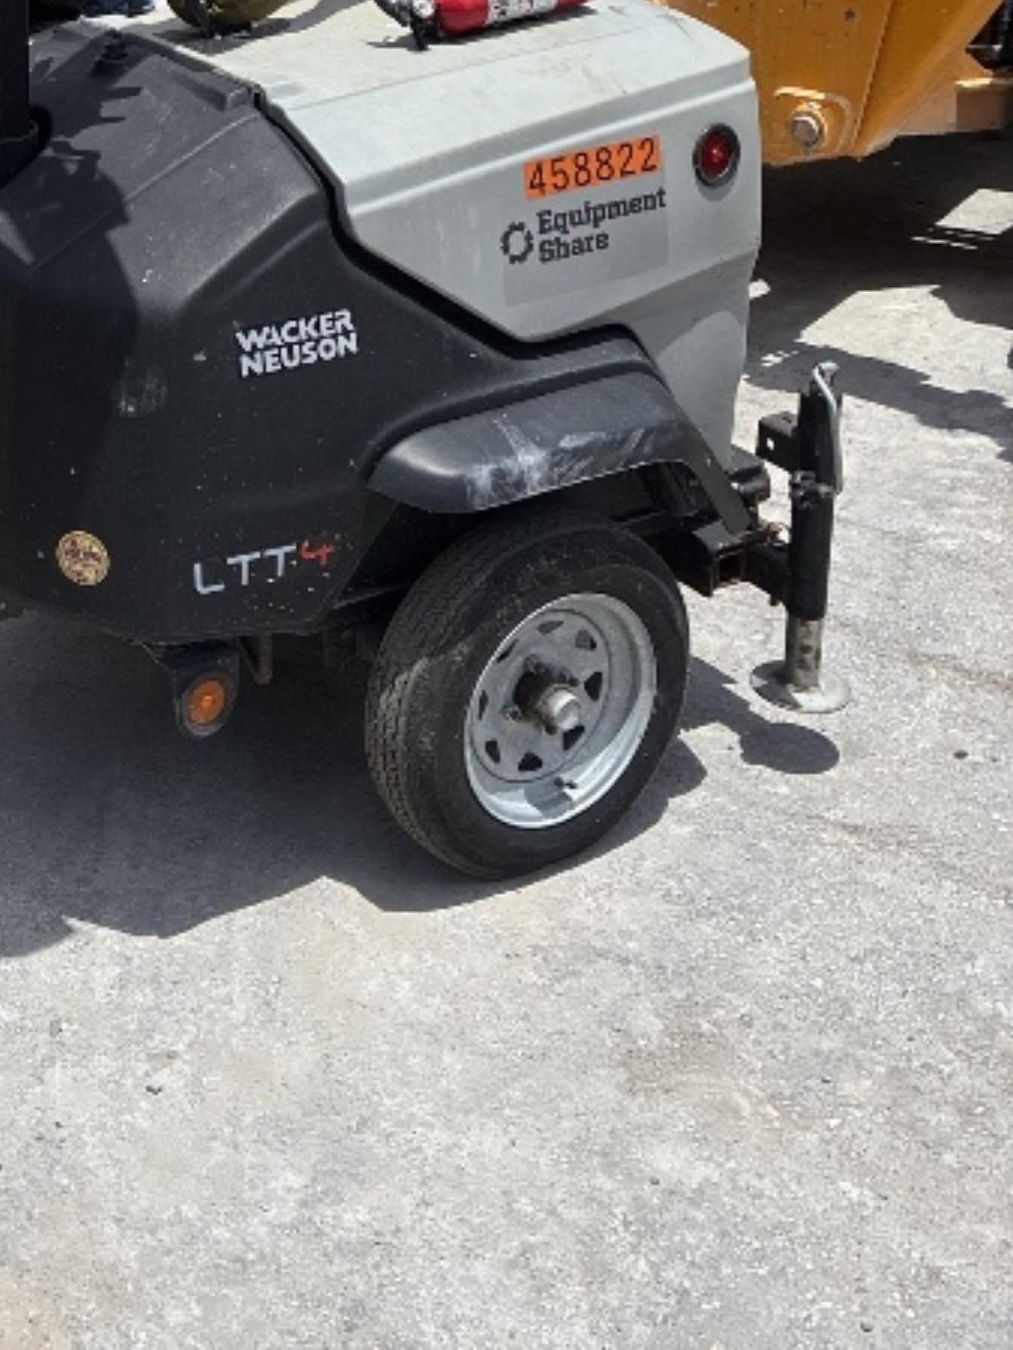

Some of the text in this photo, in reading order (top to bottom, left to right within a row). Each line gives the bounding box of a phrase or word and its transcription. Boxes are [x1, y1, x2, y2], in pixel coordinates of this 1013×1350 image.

[529, 137, 657, 195] 458822
[537, 186, 666, 235] Equipment
[539, 231, 610, 264] Share
[236, 308, 356, 352] WACKER
[240, 332, 359, 378] NEUSON
